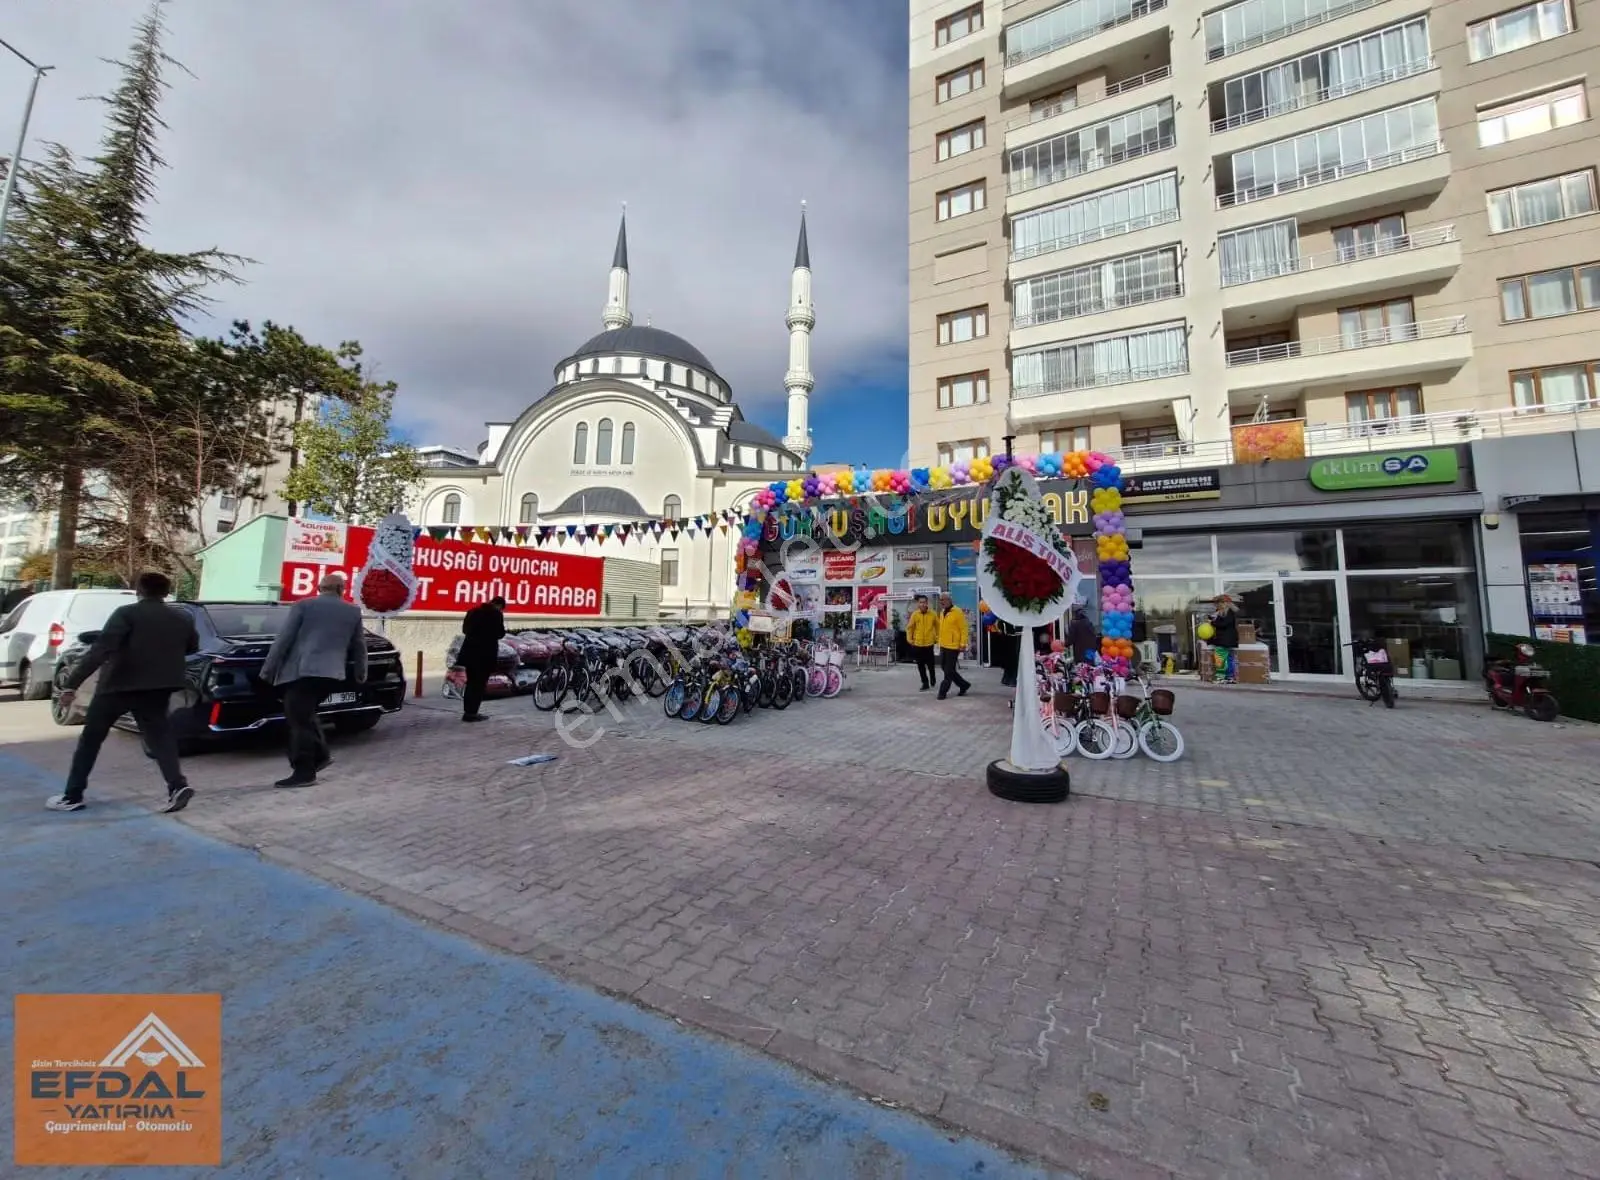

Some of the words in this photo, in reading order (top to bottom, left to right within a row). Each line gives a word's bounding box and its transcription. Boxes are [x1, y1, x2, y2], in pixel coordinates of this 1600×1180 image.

[1143, 476, 1212, 488] MITSUBISHI
[928, 490, 1088, 532] OYUAK
[302, 532, 323, 545] 20
[489, 556, 558, 577] OYUNCAK
[1037, 541, 1074, 582] TOYS
[454, 579, 529, 605] AKÜLÜ
[534, 585, 596, 608] ARABA
